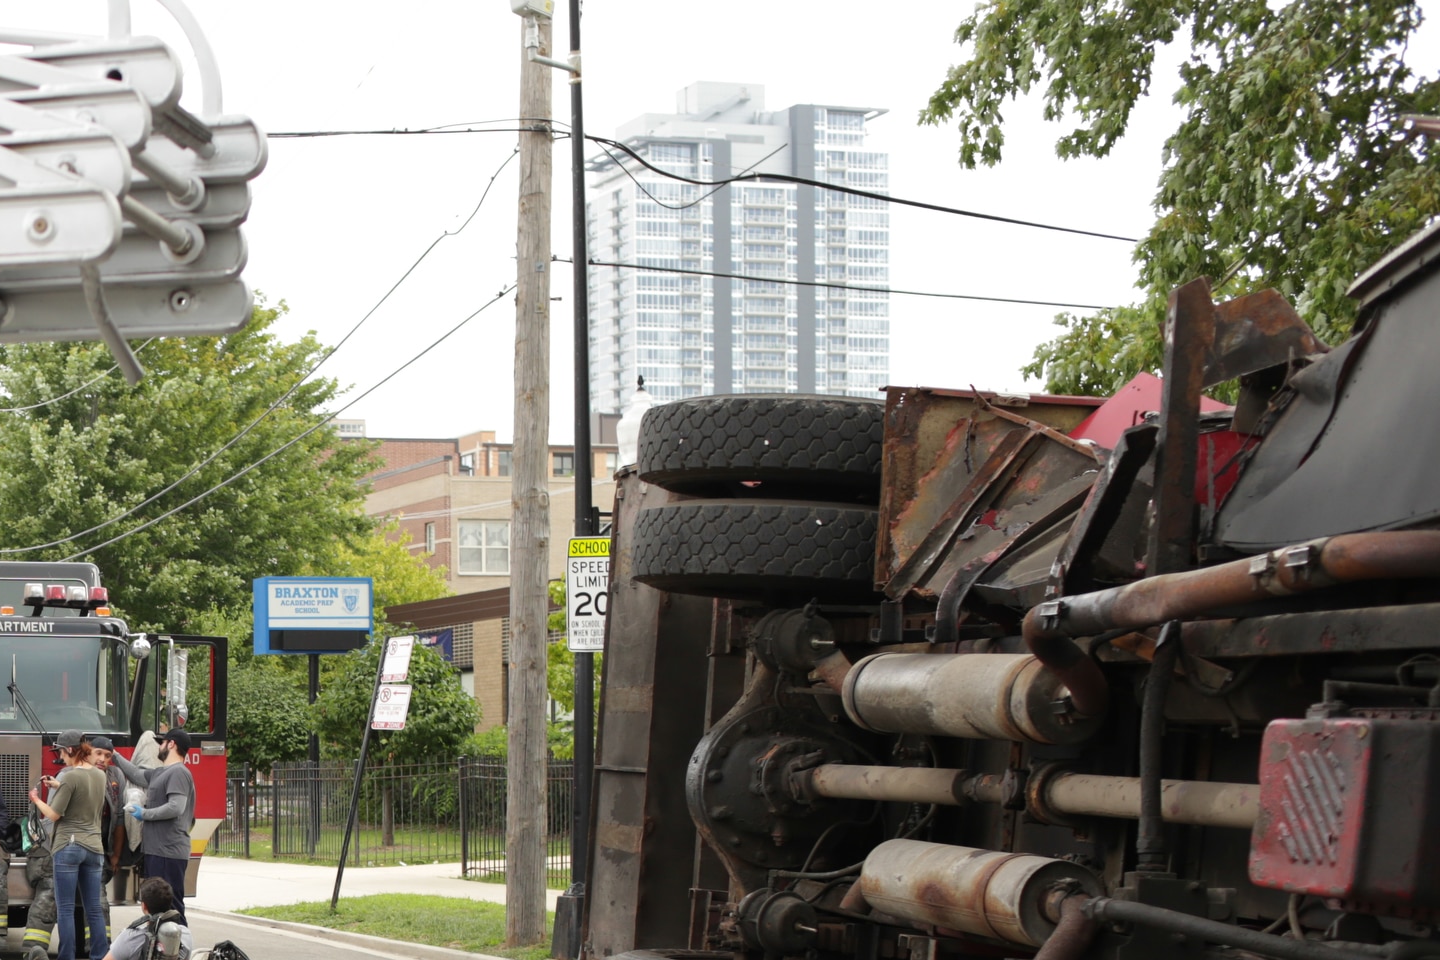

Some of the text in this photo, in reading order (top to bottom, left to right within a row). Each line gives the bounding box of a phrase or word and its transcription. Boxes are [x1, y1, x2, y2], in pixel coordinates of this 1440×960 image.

[576, 576, 608, 588] LIMIT
[275, 587, 339, 598] BRAXTON
[575, 591, 608, 616] 20
[581, 620, 600, 628] SCHOOL
[573, 629, 588, 637] WHEN
